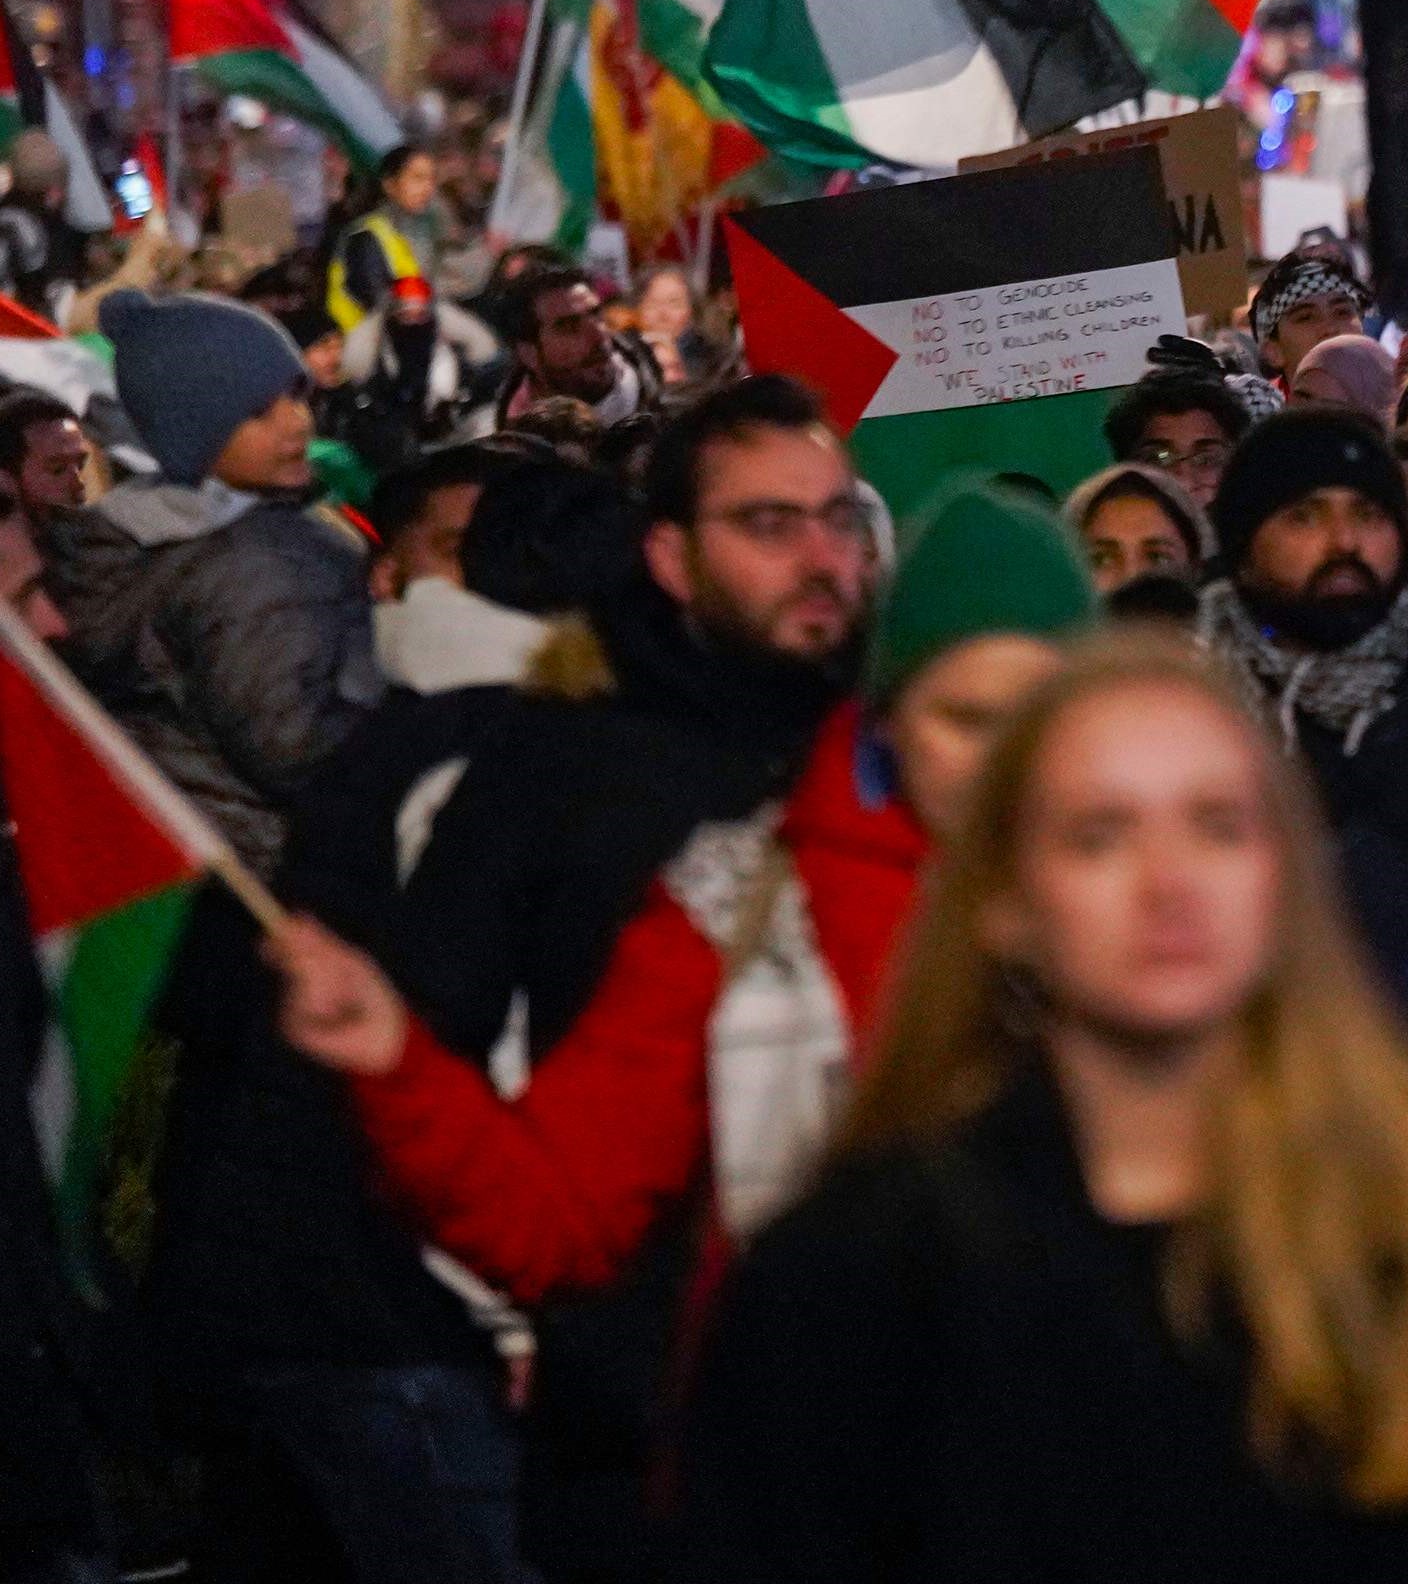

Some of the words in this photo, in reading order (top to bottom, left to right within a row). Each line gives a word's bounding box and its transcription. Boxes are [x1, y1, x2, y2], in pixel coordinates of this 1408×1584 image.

[911, 300, 945, 322] NO
[953, 295, 983, 312] TO
[997, 278, 1089, 305] GENOCIDE
[912, 325, 948, 344] NO
[958, 317, 988, 334] TO
[996, 306, 1058, 330] ETHNIC
[1063, 291, 1154, 318] CLEANSING
[914, 346, 949, 367] NO
[962, 340, 992, 357] TO
[1002, 328, 1070, 351] KILLING
[1080, 315, 1161, 337] CHILDREN
[935, 369, 980, 391] WE
[997, 360, 1051, 385] STAND
[1061, 351, 1107, 370] WITH
[973, 374, 1087, 403] PALESTINE
